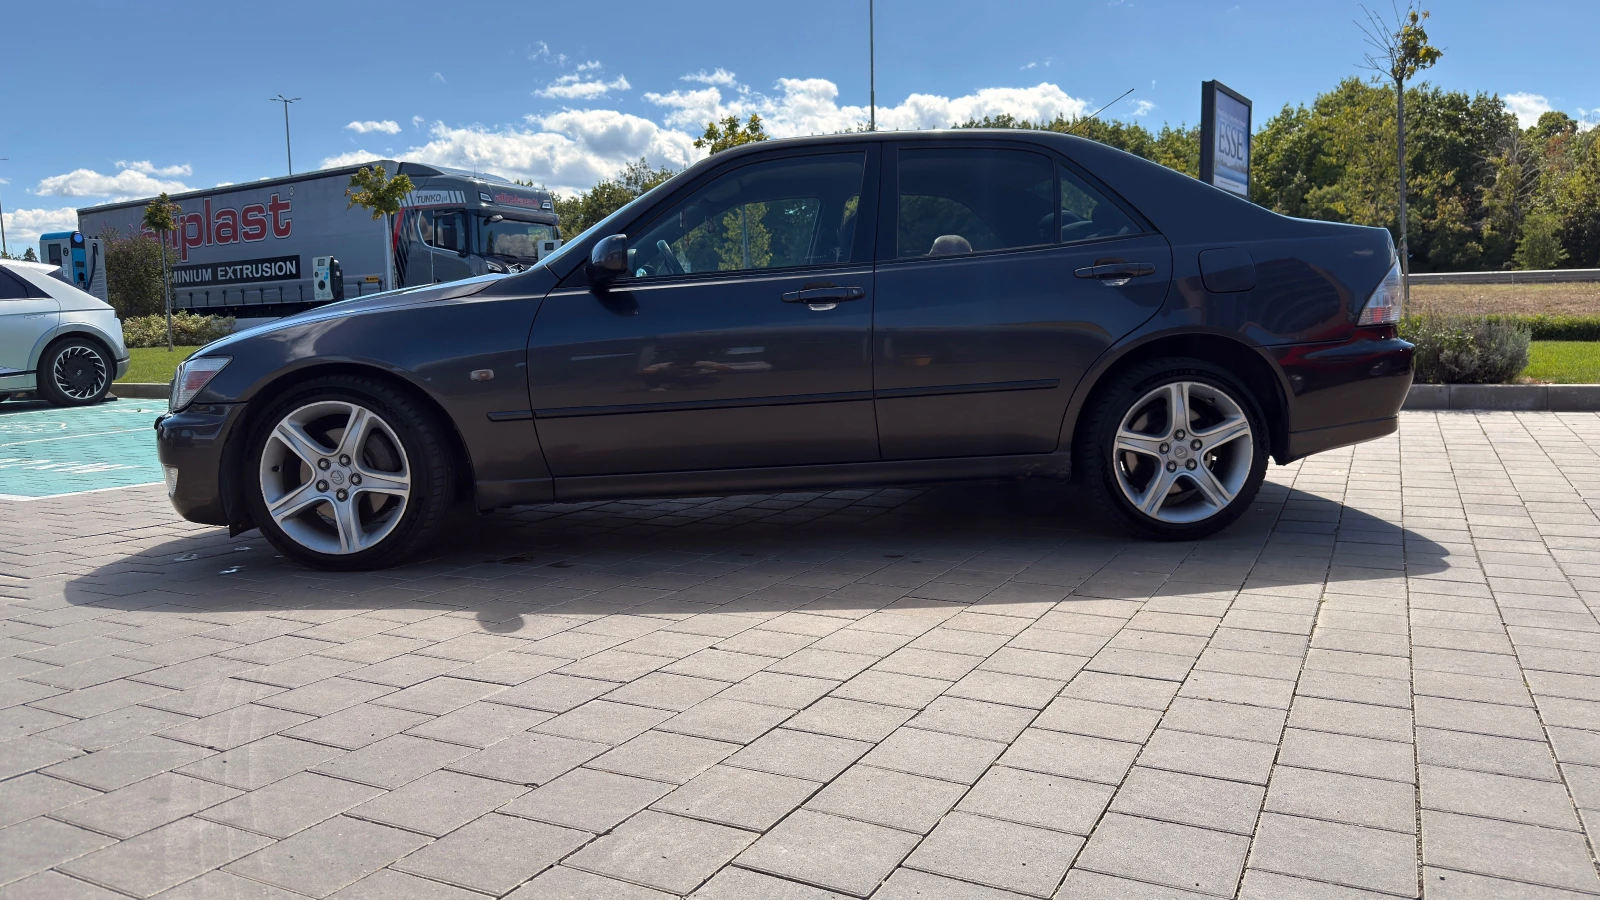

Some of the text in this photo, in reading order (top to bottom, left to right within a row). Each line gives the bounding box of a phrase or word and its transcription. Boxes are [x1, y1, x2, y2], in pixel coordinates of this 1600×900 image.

[1218, 121, 1243, 161] ESSE
[416, 193, 448, 204] TUNKO.pl
[172, 260, 296, 284] MINIUM EXTRUSION
